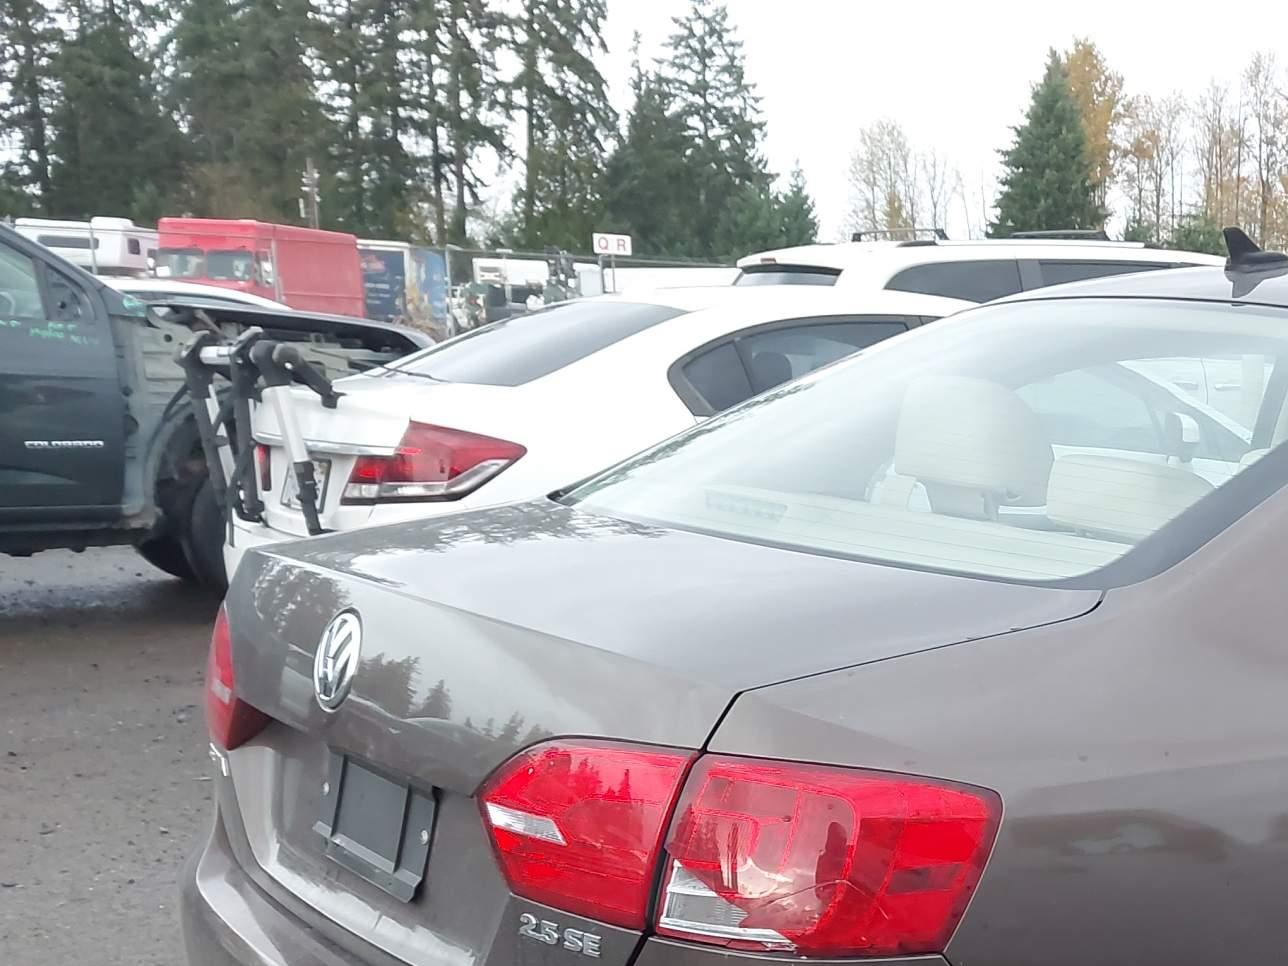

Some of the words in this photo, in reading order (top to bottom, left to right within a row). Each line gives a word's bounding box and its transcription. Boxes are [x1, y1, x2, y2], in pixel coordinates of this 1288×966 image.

[598, 236, 608, 251] Q
[617, 238, 626, 251] R
[24, 440, 104, 449] COLORADO
[563, 927, 602, 958] SE
